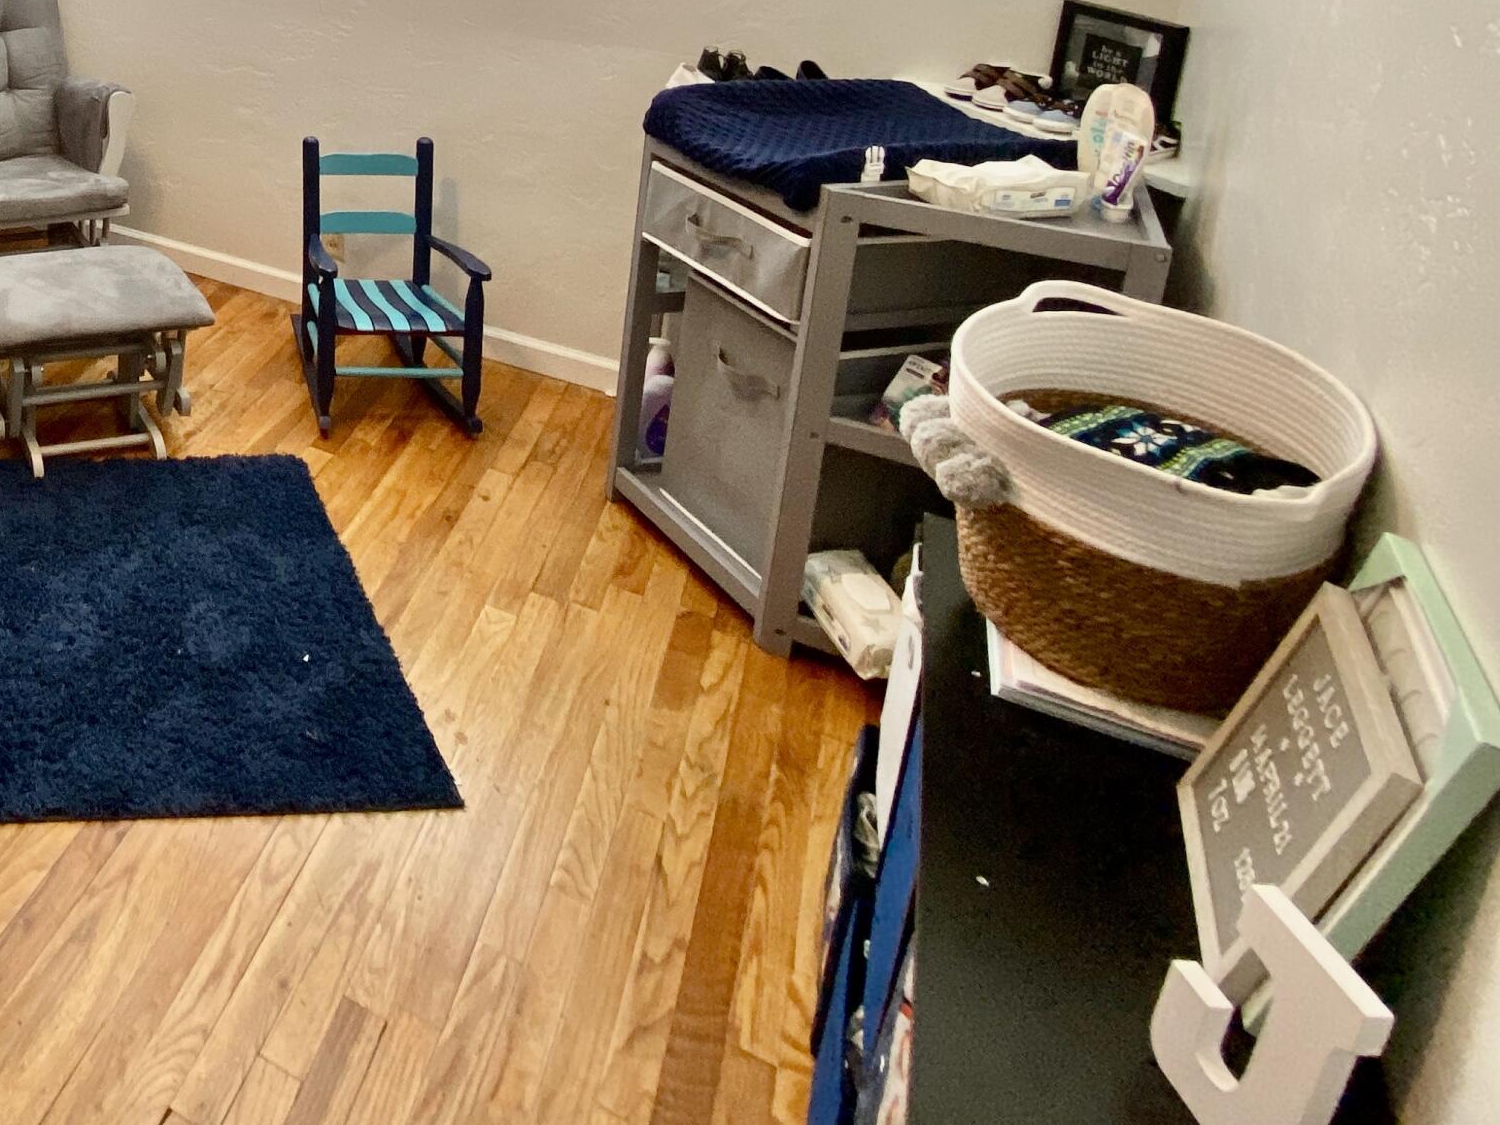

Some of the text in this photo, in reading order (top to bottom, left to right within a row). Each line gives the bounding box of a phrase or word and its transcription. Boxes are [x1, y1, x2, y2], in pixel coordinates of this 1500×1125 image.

[1092, 50, 1129, 66] LIGHT
[1283, 674, 1332, 802] LEGGETT
[1313, 674, 1349, 748] JACE
[1150, 884, 1394, 1125] J
